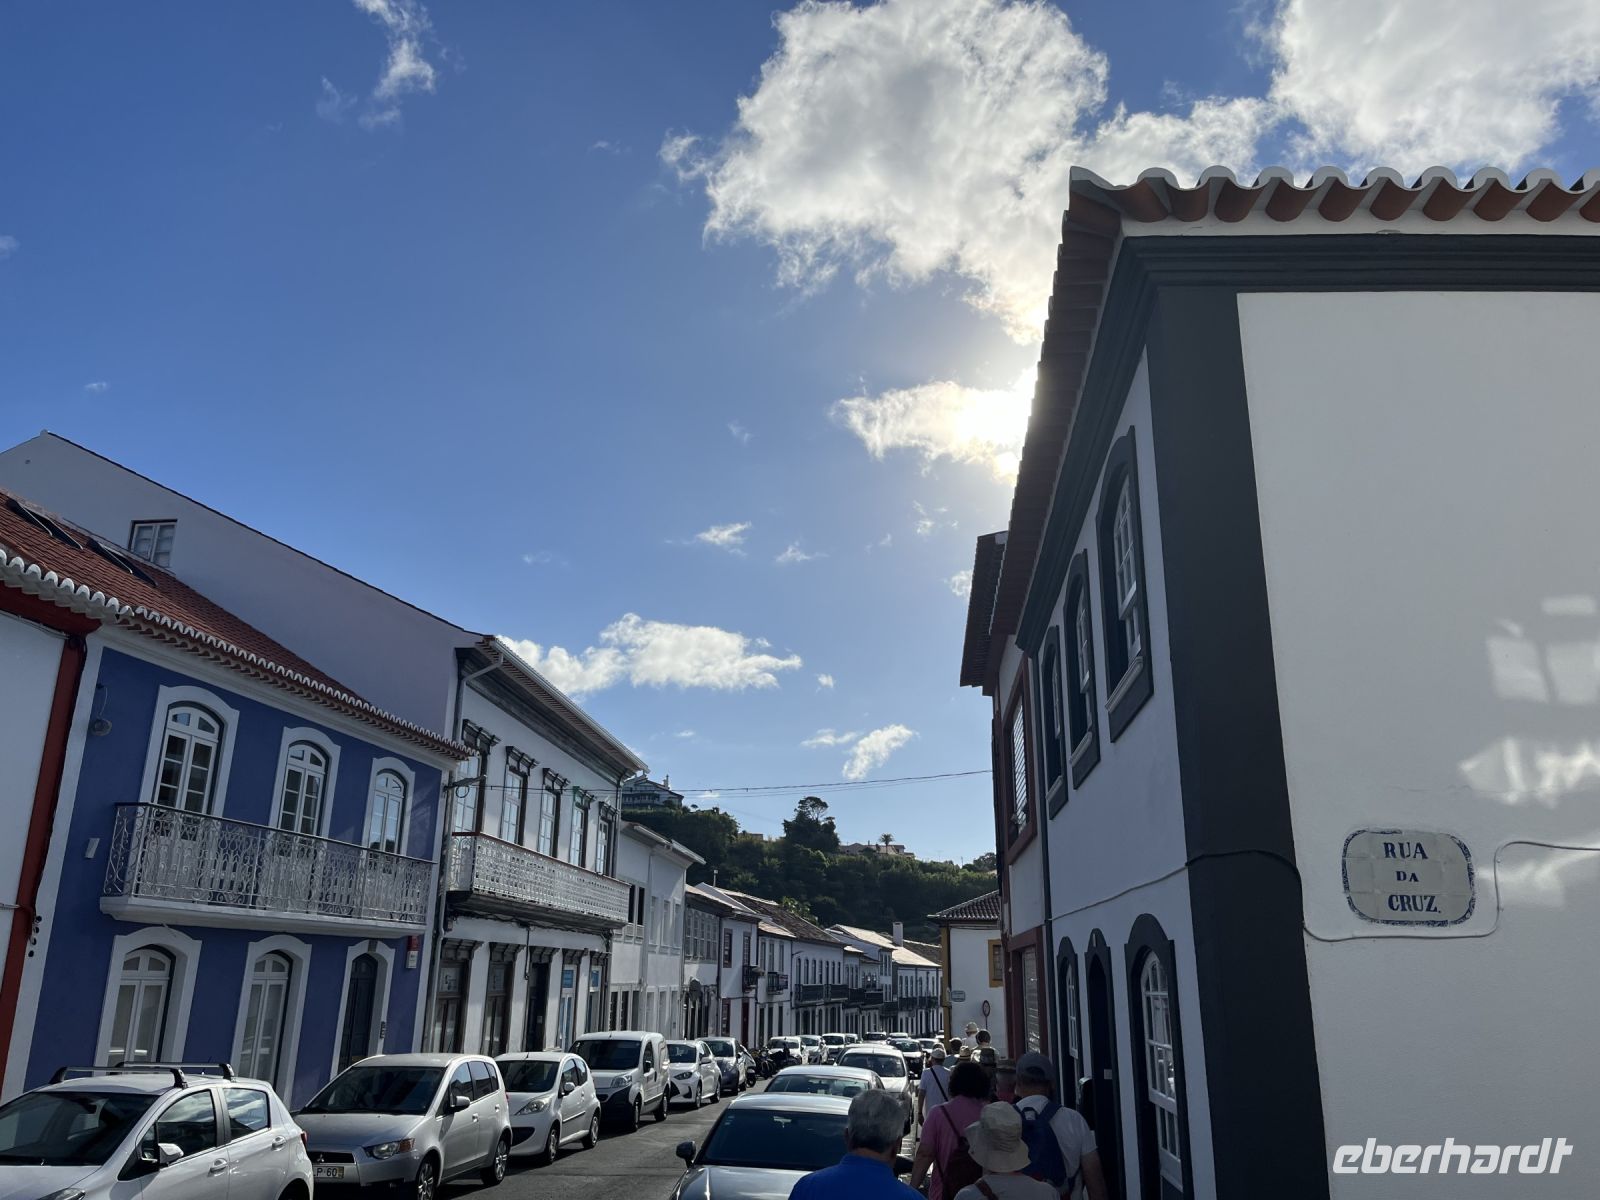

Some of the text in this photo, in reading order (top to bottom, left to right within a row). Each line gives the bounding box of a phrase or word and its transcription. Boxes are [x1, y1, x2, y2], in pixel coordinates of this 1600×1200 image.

[1383, 841, 1429, 860] RUA
[1395, 870, 1419, 882] DA
[1387, 894, 1441, 914] CRUZ.
